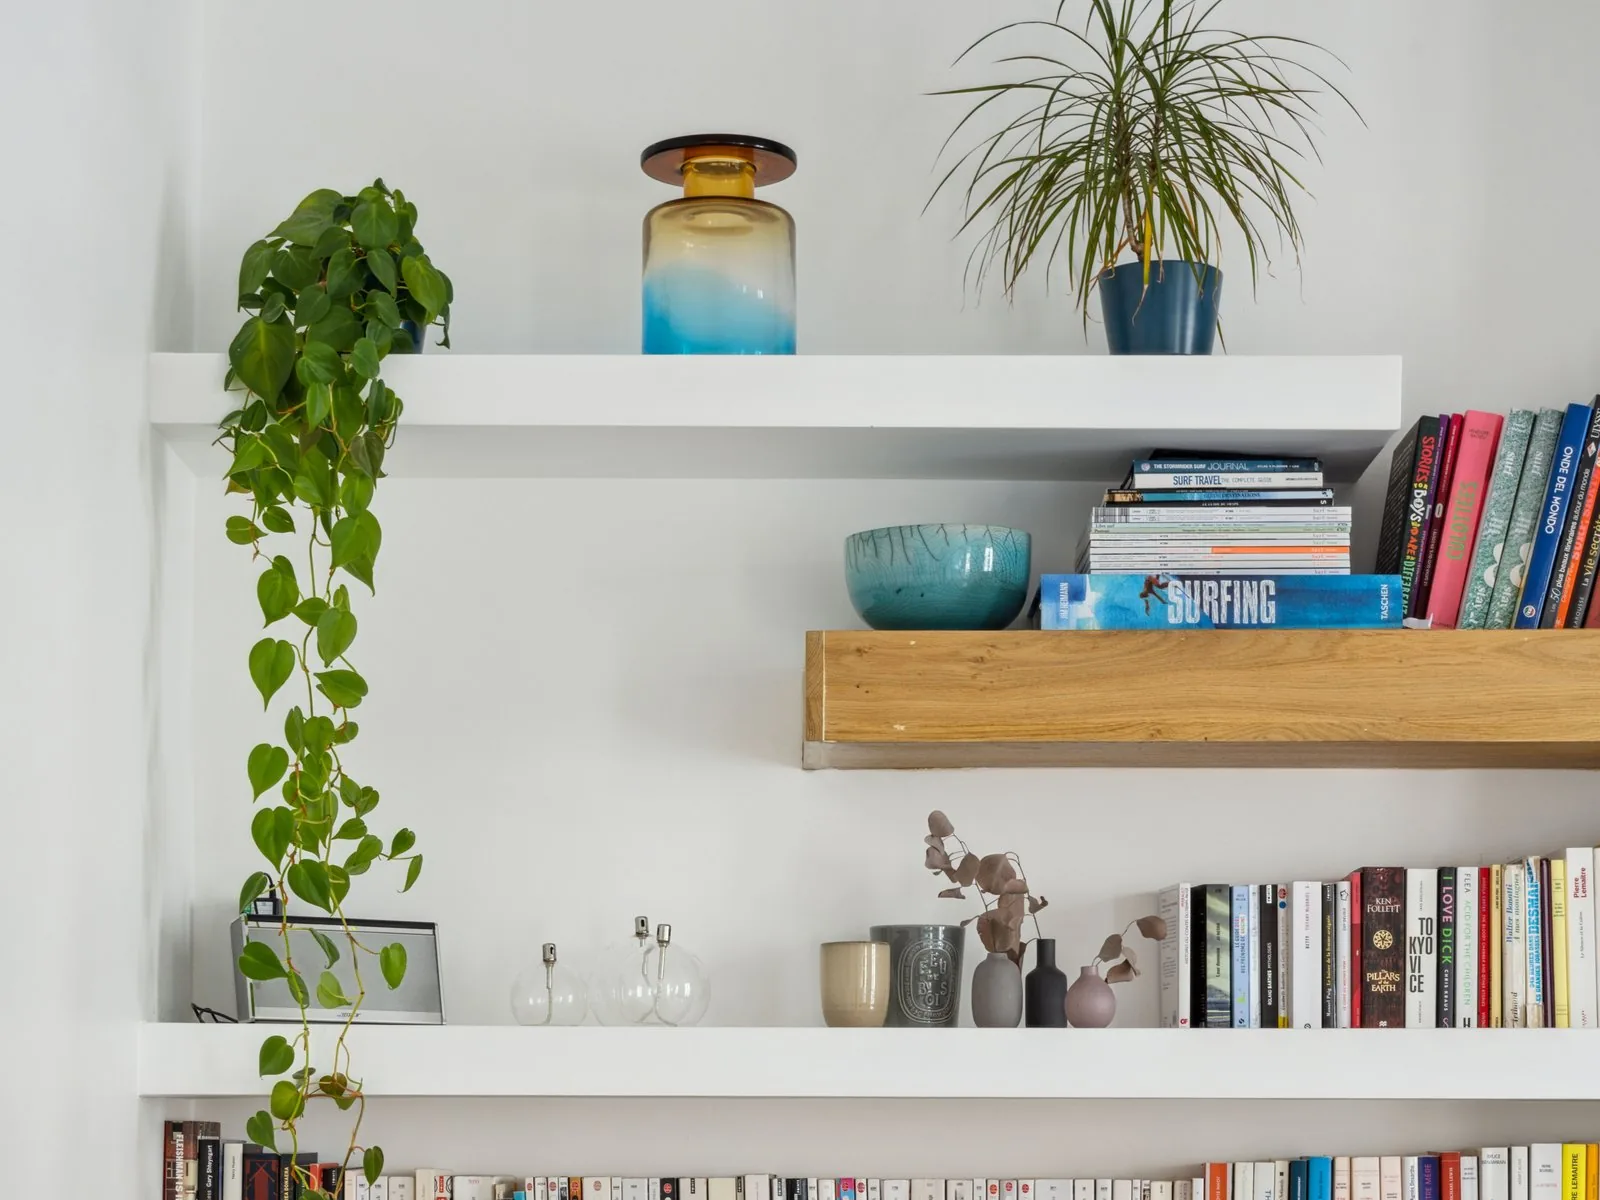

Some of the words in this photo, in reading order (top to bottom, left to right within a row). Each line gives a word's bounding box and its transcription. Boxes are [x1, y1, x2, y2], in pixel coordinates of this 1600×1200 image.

[1207, 462, 1250, 471] JOURNAL
[1416, 435, 1436, 483] STORIES
[1558, 446, 1574, 473] ONDE
[1173, 475, 1193, 486] SURF
[1195, 475, 1221, 486] TRAVEL
[1556, 474, 1566, 496] DEL
[1578, 468, 1590, 490] monde
[1576, 491, 1585, 500] du
[1409, 489, 1428, 522] BOYS
[1571, 501, 1583, 521] autour
[1545, 496, 1561, 535] MONDO
[1563, 521, 1578, 552] itinéraires
[1559, 553, 1569, 573] beaux
[1583, 558, 1596, 577] vie
[1556, 573, 1565, 588] plus
[1581, 577, 1590, 587] La
[1168, 579, 1276, 625] SURFING
[1381, 583, 1389, 620] TASCHEN
[1550, 587, 1562, 603] 50
[1573, 596, 1585, 629] LAROUSSE
[1367, 904, 1401, 913] FOLLETT
[1375, 897, 1392, 905] KEN
[1442, 886, 1453, 923] LOVE
[1463, 899, 1472, 921] ACID
[1418, 917, 1434, 936] TO
[1463, 923, 1472, 941] FOR
[1409, 936, 1434, 955] KYO
[1442, 928, 1453, 964] DICK
[1463, 943, 1472, 959] THE
[1409, 955, 1421, 974] VI
[1366, 971, 1400, 982] PILLARS
[1409, 974, 1424, 993] CE
[1463, 961, 1473, 1006] CHILDREN
[1371, 984, 1396, 994] EARTH
[175, 1134, 184, 1179] FLEISHMAN
[206, 1144, 214, 1174] Shteyngart
[206, 1174, 214, 1188] Gary
[1570, 1153, 1578, 1190] LEMAITRE
[175, 1181, 184, 1192] IS
